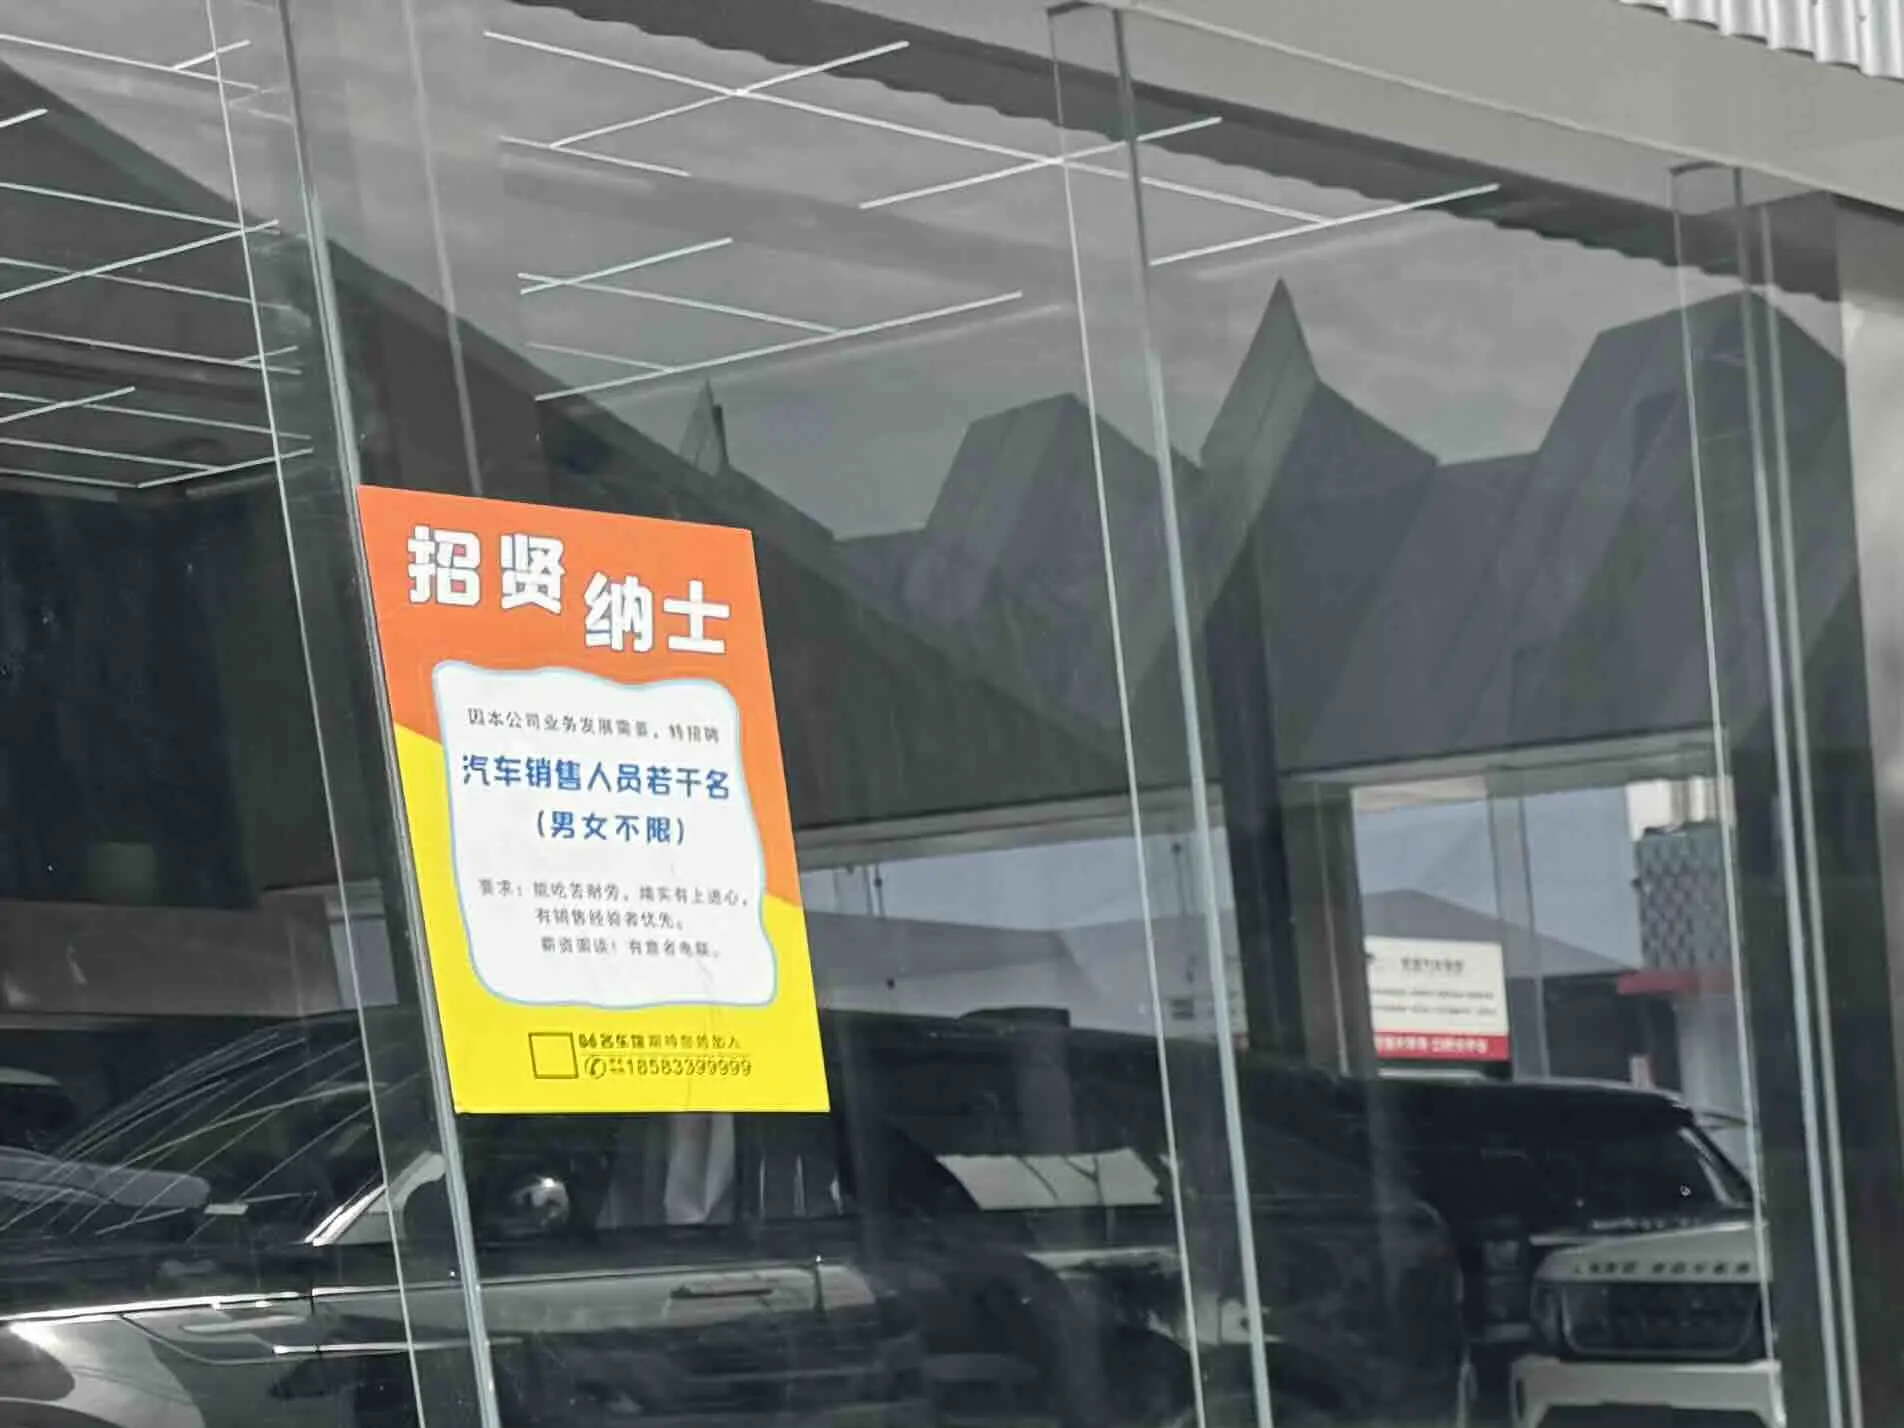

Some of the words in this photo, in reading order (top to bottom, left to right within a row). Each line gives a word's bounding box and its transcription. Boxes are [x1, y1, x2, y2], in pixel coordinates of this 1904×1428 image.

[407, 524, 731, 654] 招贤纳士
[462, 753, 730, 800] 汽车销售人员若干名
[536, 808, 685, 845] （男女不限）
